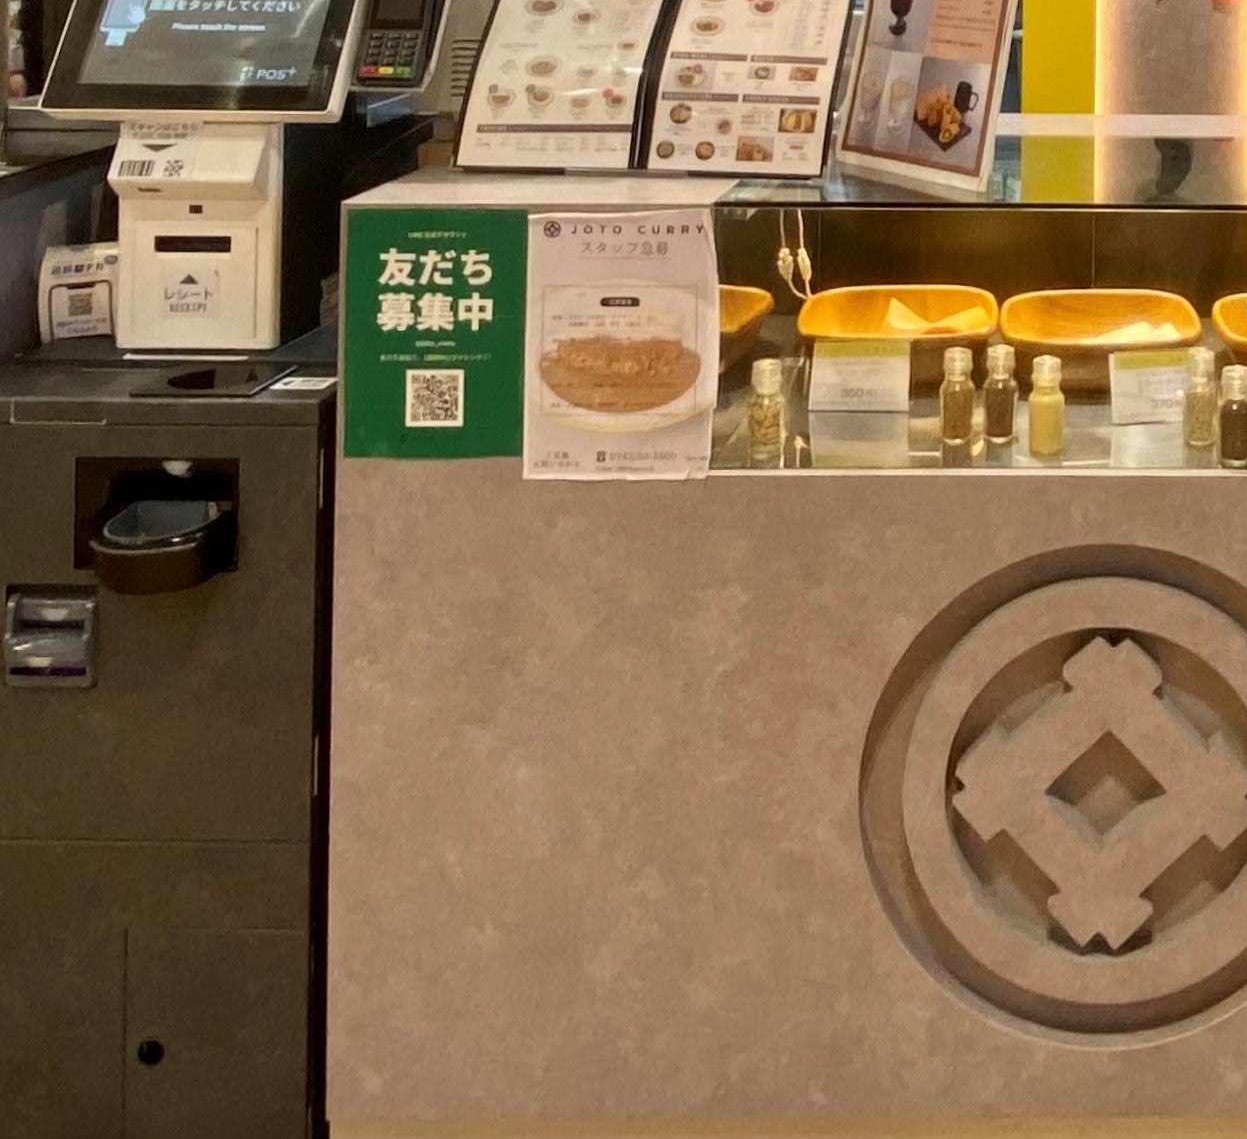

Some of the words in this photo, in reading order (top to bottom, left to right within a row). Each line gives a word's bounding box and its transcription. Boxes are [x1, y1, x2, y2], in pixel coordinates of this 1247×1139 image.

[570, 224, 622, 236] JOTO
[637, 224, 705, 236] CURRY
[378, 247, 493, 286] 友だち
[163, 286, 214, 301] レシート
[376, 292, 494, 332] 募集中
